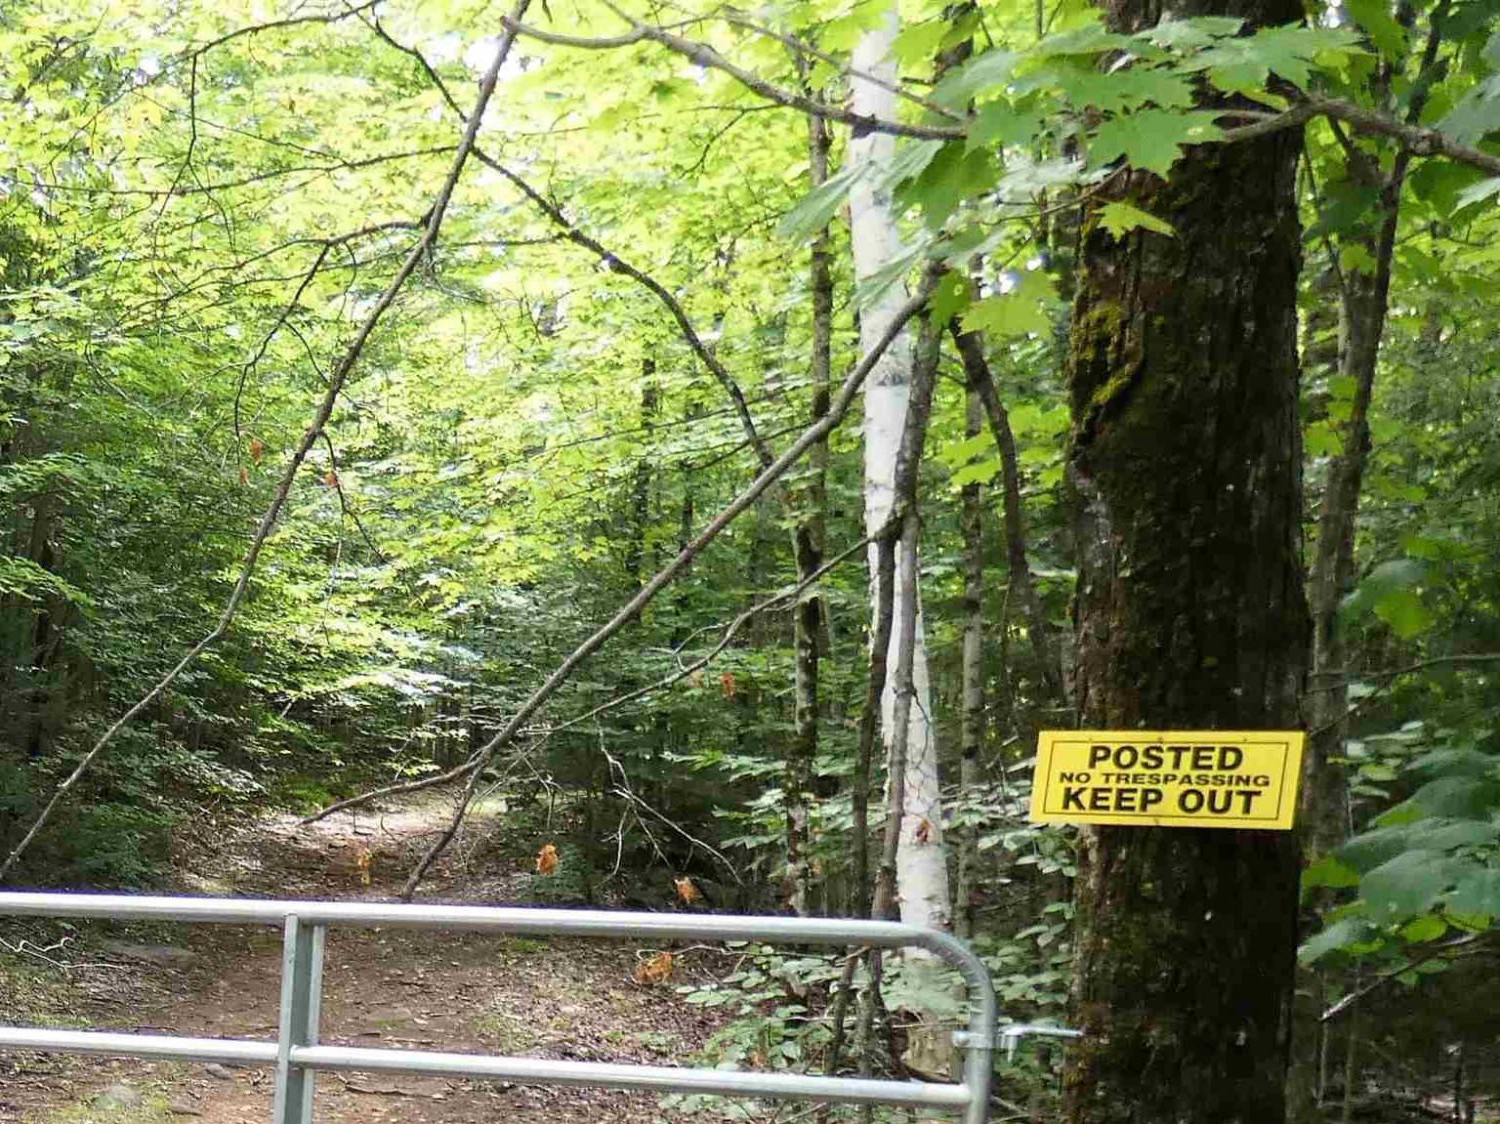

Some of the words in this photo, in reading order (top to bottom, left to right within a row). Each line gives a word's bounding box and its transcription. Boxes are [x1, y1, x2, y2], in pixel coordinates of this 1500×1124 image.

[1088, 745, 1243, 771] POSTED
[1059, 772, 1091, 784] NO
[1102, 773, 1270, 787] TRESPASSING
[1062, 787, 1162, 812] KEEP
[1178, 790, 1261, 815] OUT
